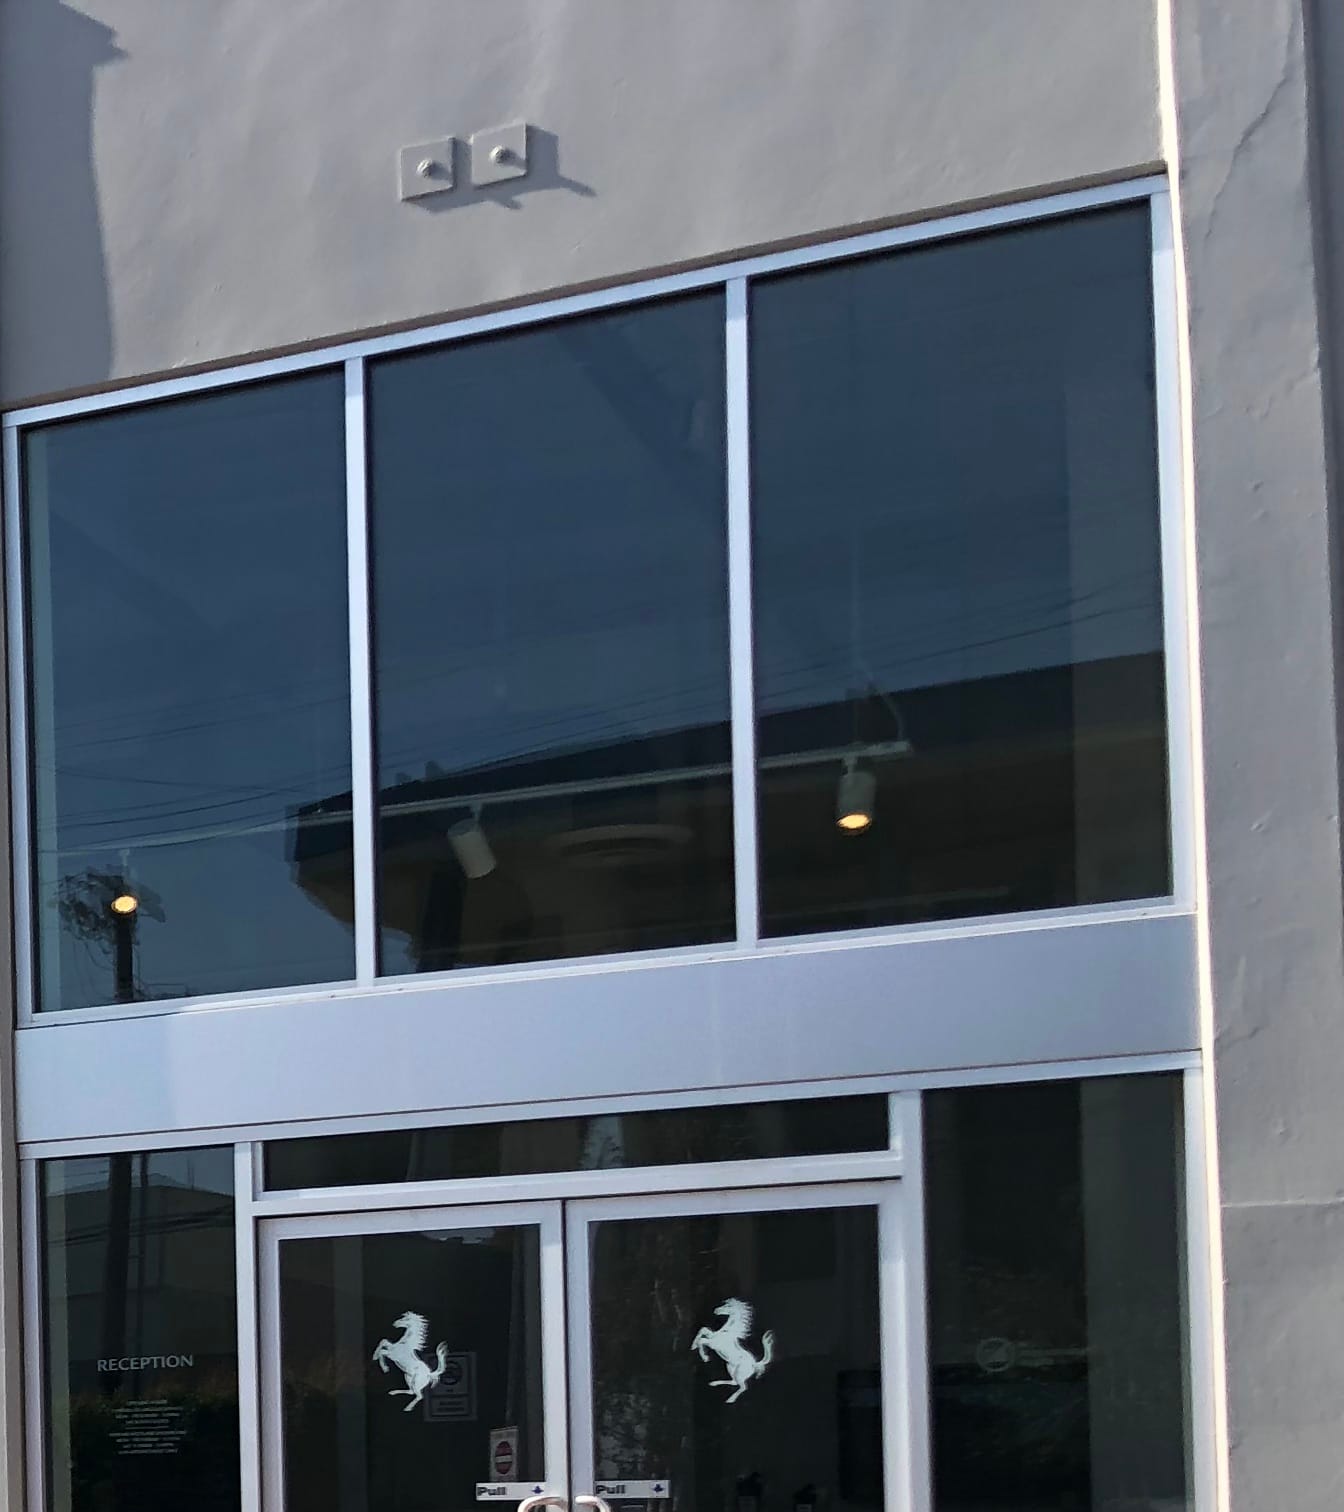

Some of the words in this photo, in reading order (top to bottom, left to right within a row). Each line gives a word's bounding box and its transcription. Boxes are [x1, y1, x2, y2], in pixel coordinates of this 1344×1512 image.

[97, 1354, 193, 1372] RECEPTION
[477, 1486, 507, 1497] Pull
[595, 1484, 626, 1495] Pull
